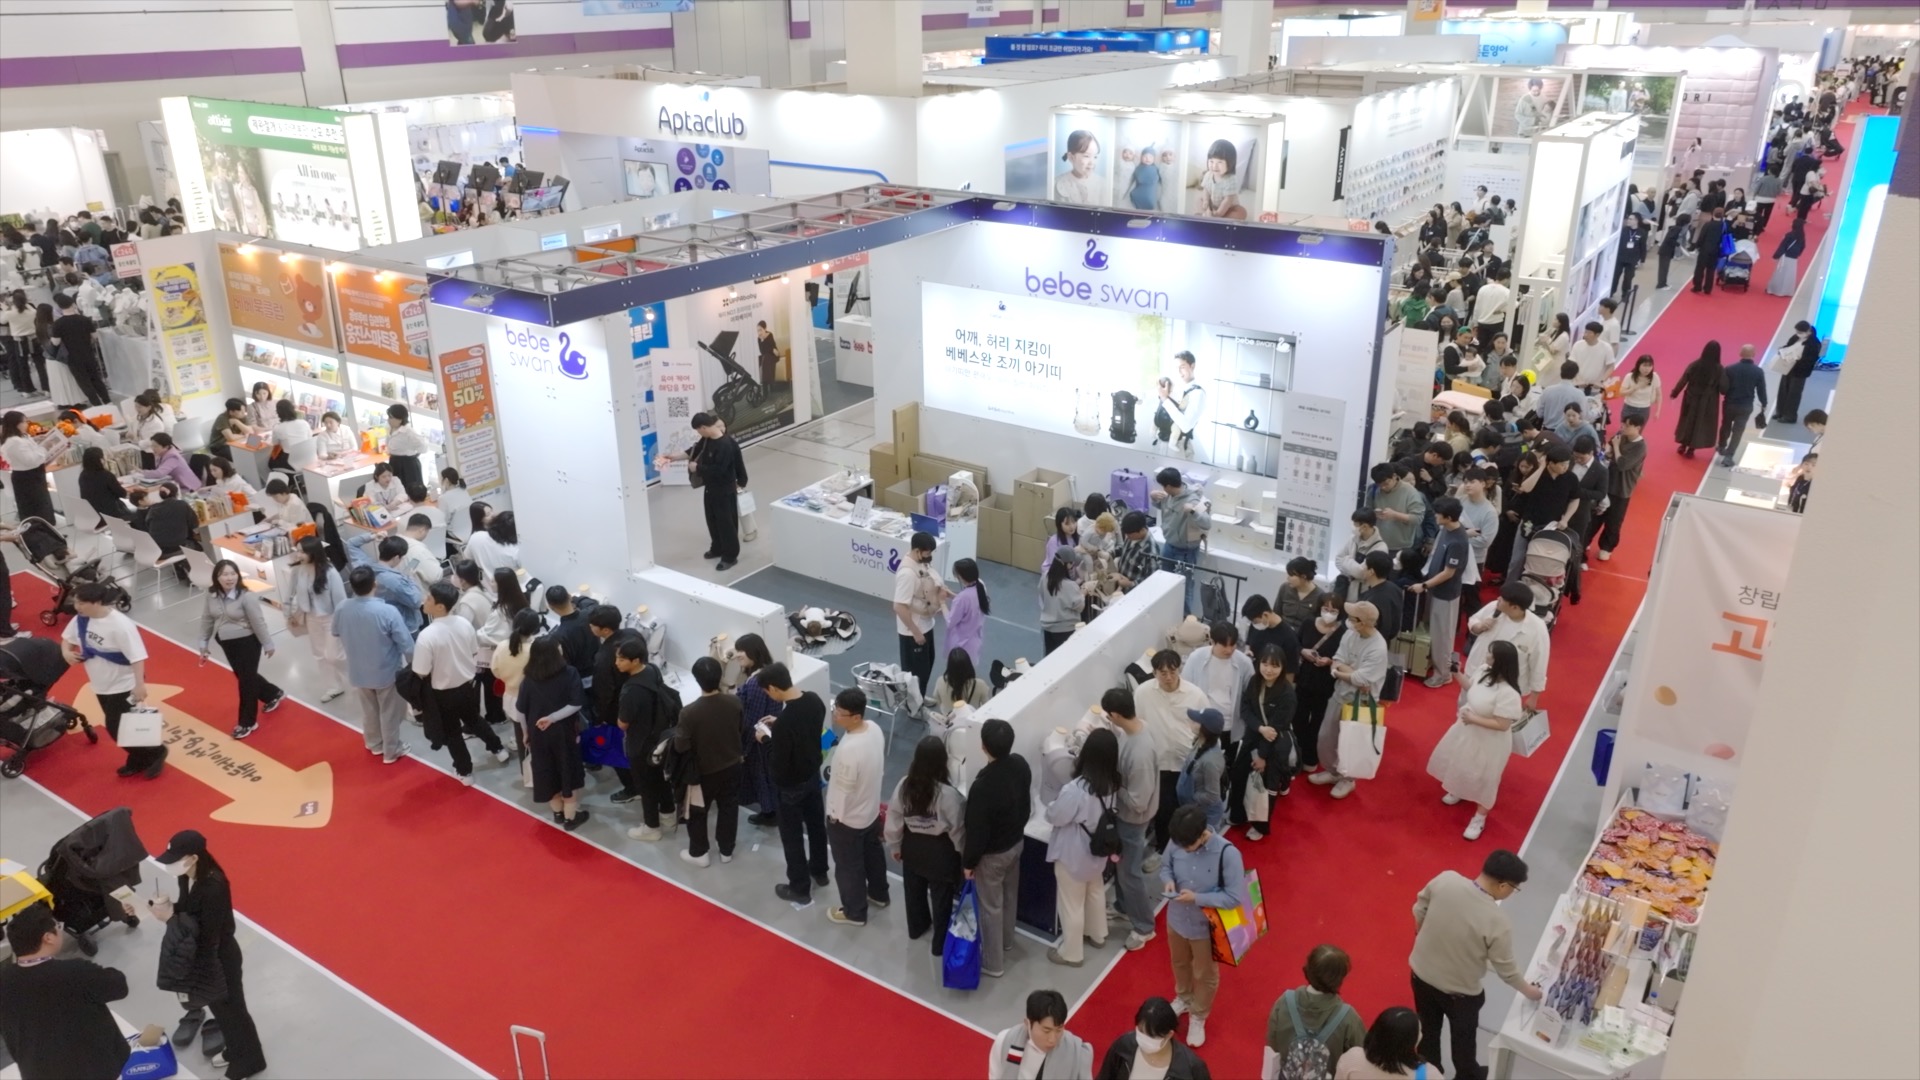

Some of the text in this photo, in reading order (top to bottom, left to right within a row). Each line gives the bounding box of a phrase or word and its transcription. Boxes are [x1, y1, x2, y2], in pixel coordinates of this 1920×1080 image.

[658, 105, 744, 136] Aptaclub
[296, 164, 337, 182] All in one
[1025, 266, 1169, 311] bebe swan
[404, 305, 422, 317] C260
[345, 322, 401, 355] 웅진스마트올
[504, 323, 550, 353] bebe
[955, 328, 1051, 359] 어깨, 허리 지킴이
[509, 351, 555, 374] swan
[945, 346, 1061, 381] 베베스완 조끼 아기띠
[453, 386, 485, 408] 50%
[851, 538, 883, 559] bebe
[852, 553, 885, 572] swan
[1738, 585, 1781, 611] 창립
[1711, 611, 1768, 662] 고
